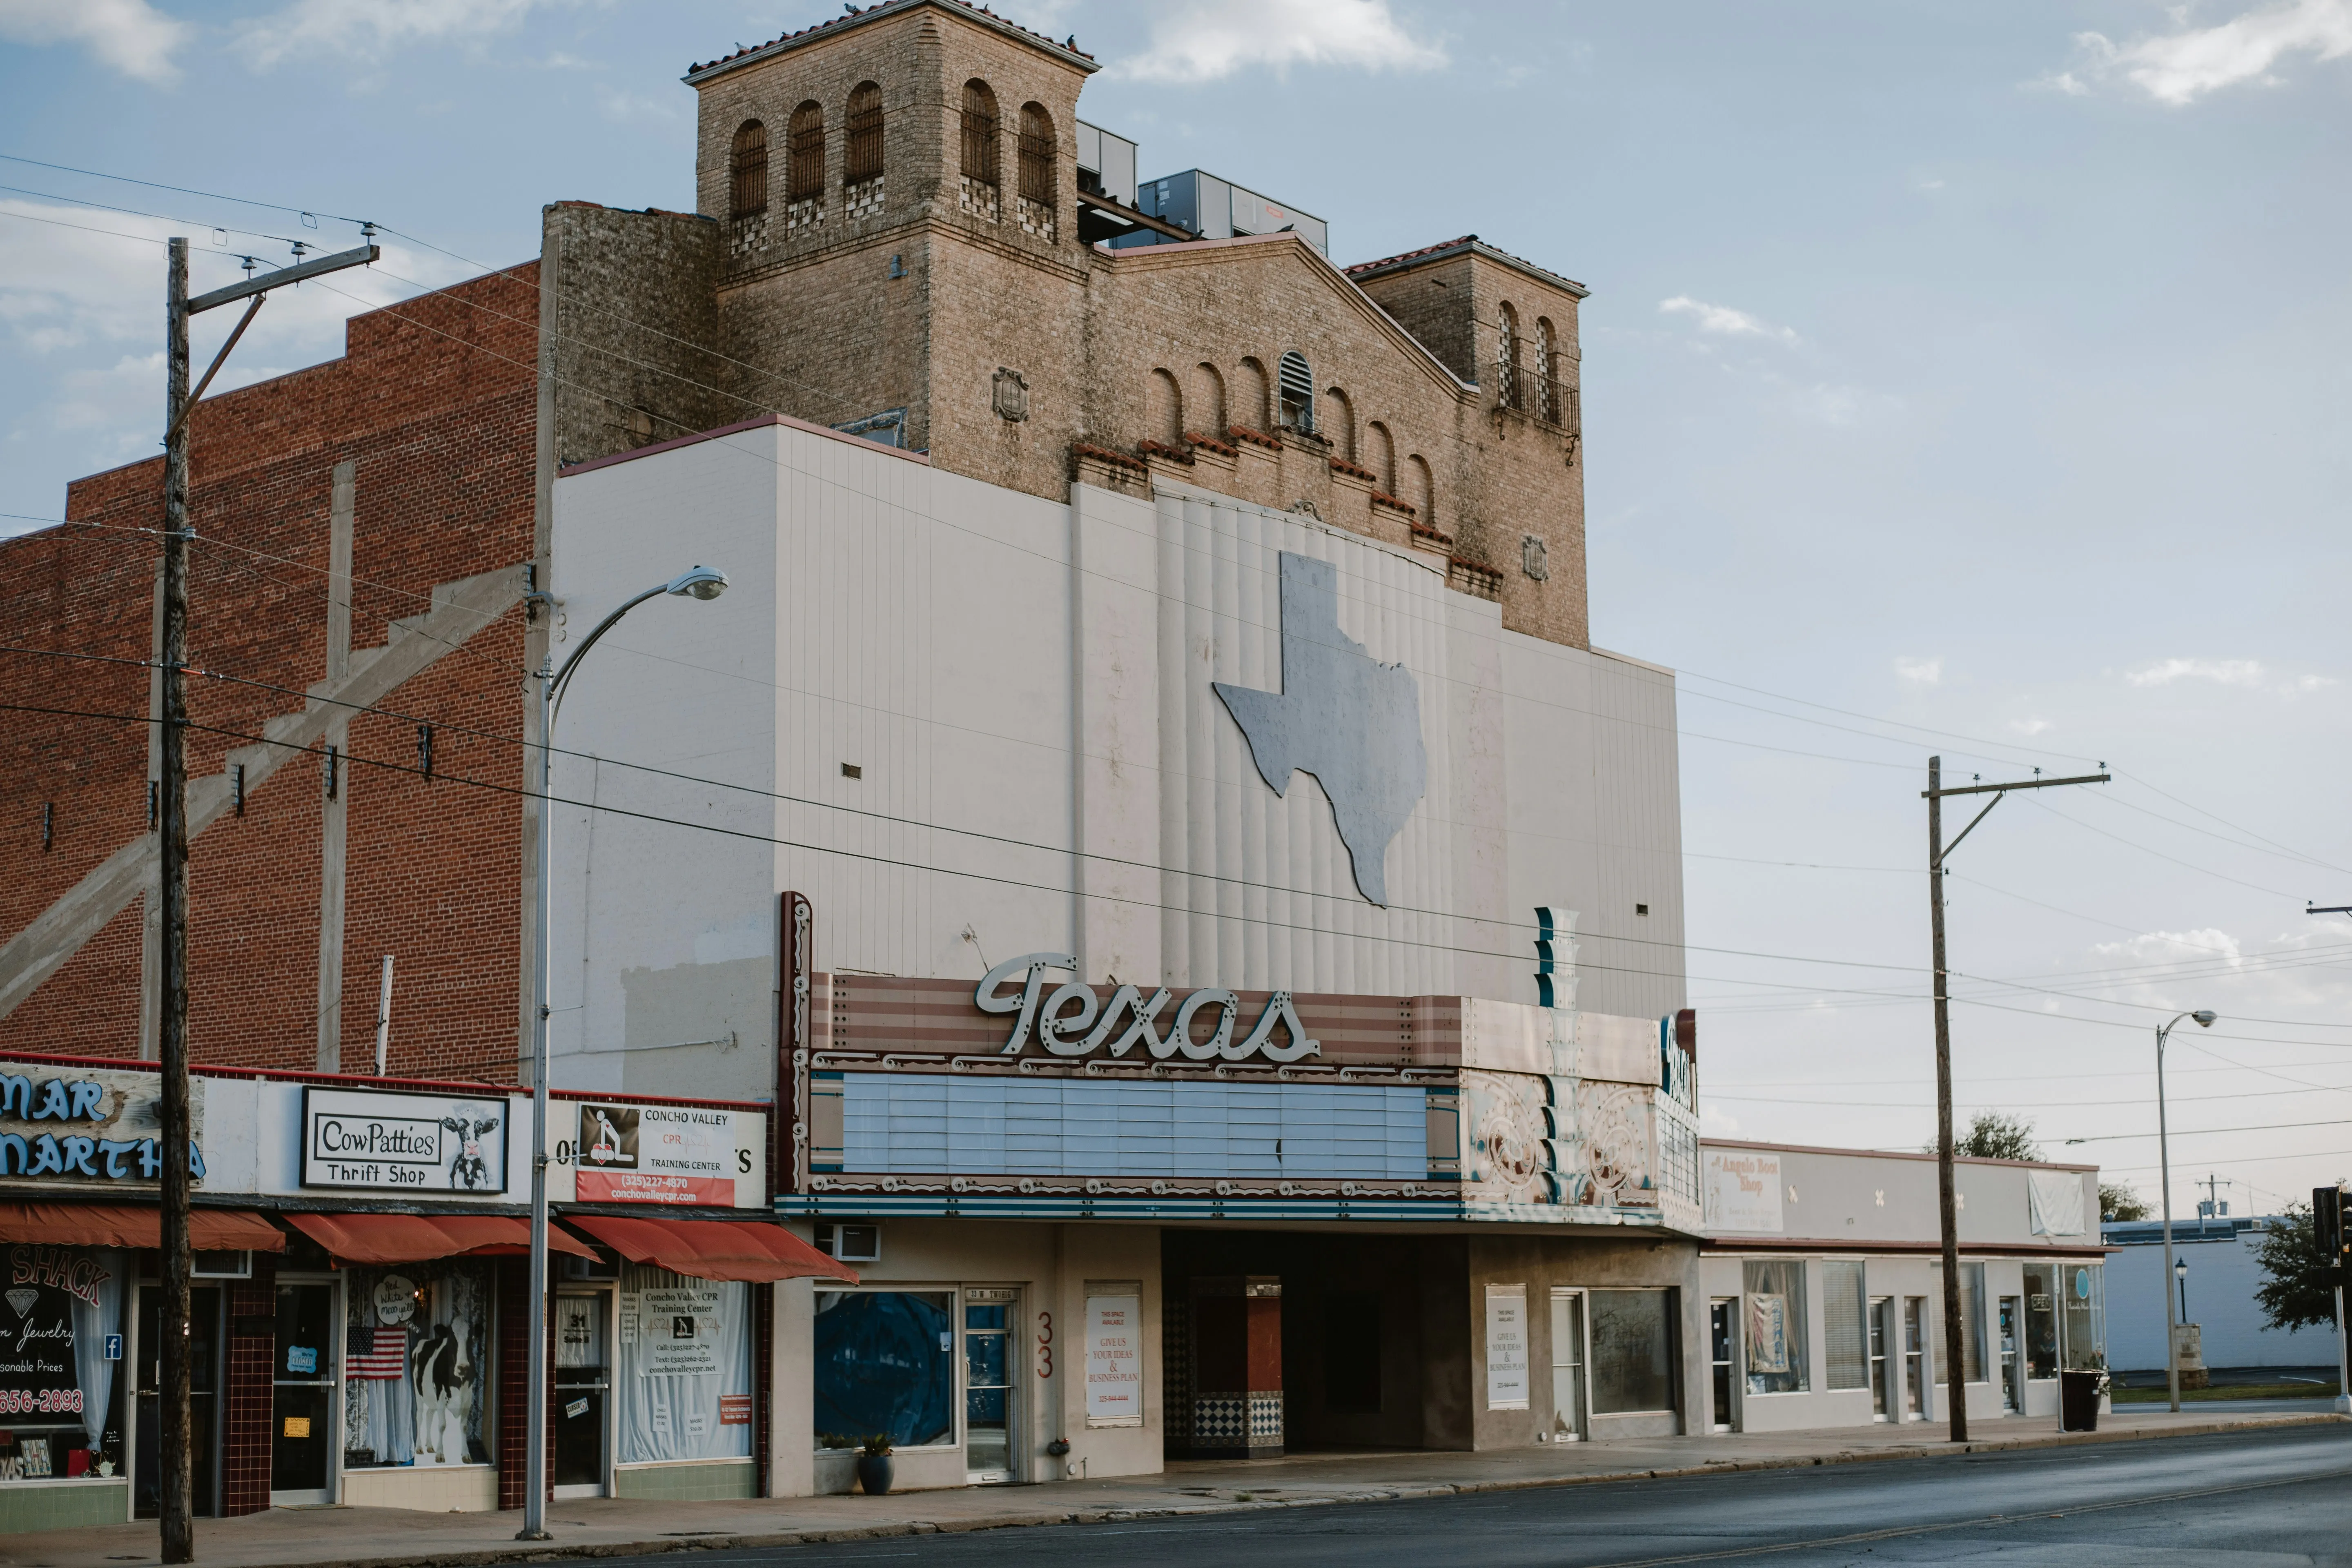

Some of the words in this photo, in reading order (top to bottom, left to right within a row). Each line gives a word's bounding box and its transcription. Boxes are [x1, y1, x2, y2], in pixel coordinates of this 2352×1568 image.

[974, 952, 1321, 1062] Texas
[645, 1109, 688, 1123] CONCHO
[692, 1113, 728, 1126] VALLEY
[663, 1134, 681, 1145] CPR
[651, 1159, 690, 1169] TRAINING
[692, 1161, 721, 1171] CENTER
[327, 1165, 380, 1182] Thrift
[389, 1165, 425, 1185] Shop
[621, 1175, 688, 1188] (325)227-4870
[1740, 1175, 1763, 1197] Shop
[611, 1189, 696, 1202] conchovalleycpr.com
[11, 1245, 111, 1307] SHACK
[646, 1292, 675, 1302] Concho
[677, 1292, 700, 1304] Valley
[702, 1292, 719, 1301] CPR
[990, 1290, 1011, 1298] TWOHIG
[652, 1304, 686, 1314] Training
[687, 1303, 713, 1313] Center
[571, 1315, 585, 1327] 31
[16, 1317, 75, 1352] Jewelry
[564, 1335, 582, 1343] Suite
[1100, 1338, 1116, 1347] GIVE
[1118, 1338, 1126, 1346] US
[292, 1356, 313, 1365] CLOSED
[1093, 1351, 1113, 1359] YOUR
[1114, 1350, 1133, 1359] IDEAS
[1504, 1352, 1510, 1363] &
[37, 1359, 63, 1372] Prices
[649, 1365, 716, 1374] conchovalleycpr.net
[1109, 1360, 1118, 1372] &
[1089, 1374, 1120, 1383] BUSINESS
[1121, 1373, 1138, 1382] PLAN
[0, 1389, 83, 1413] 656-2893
